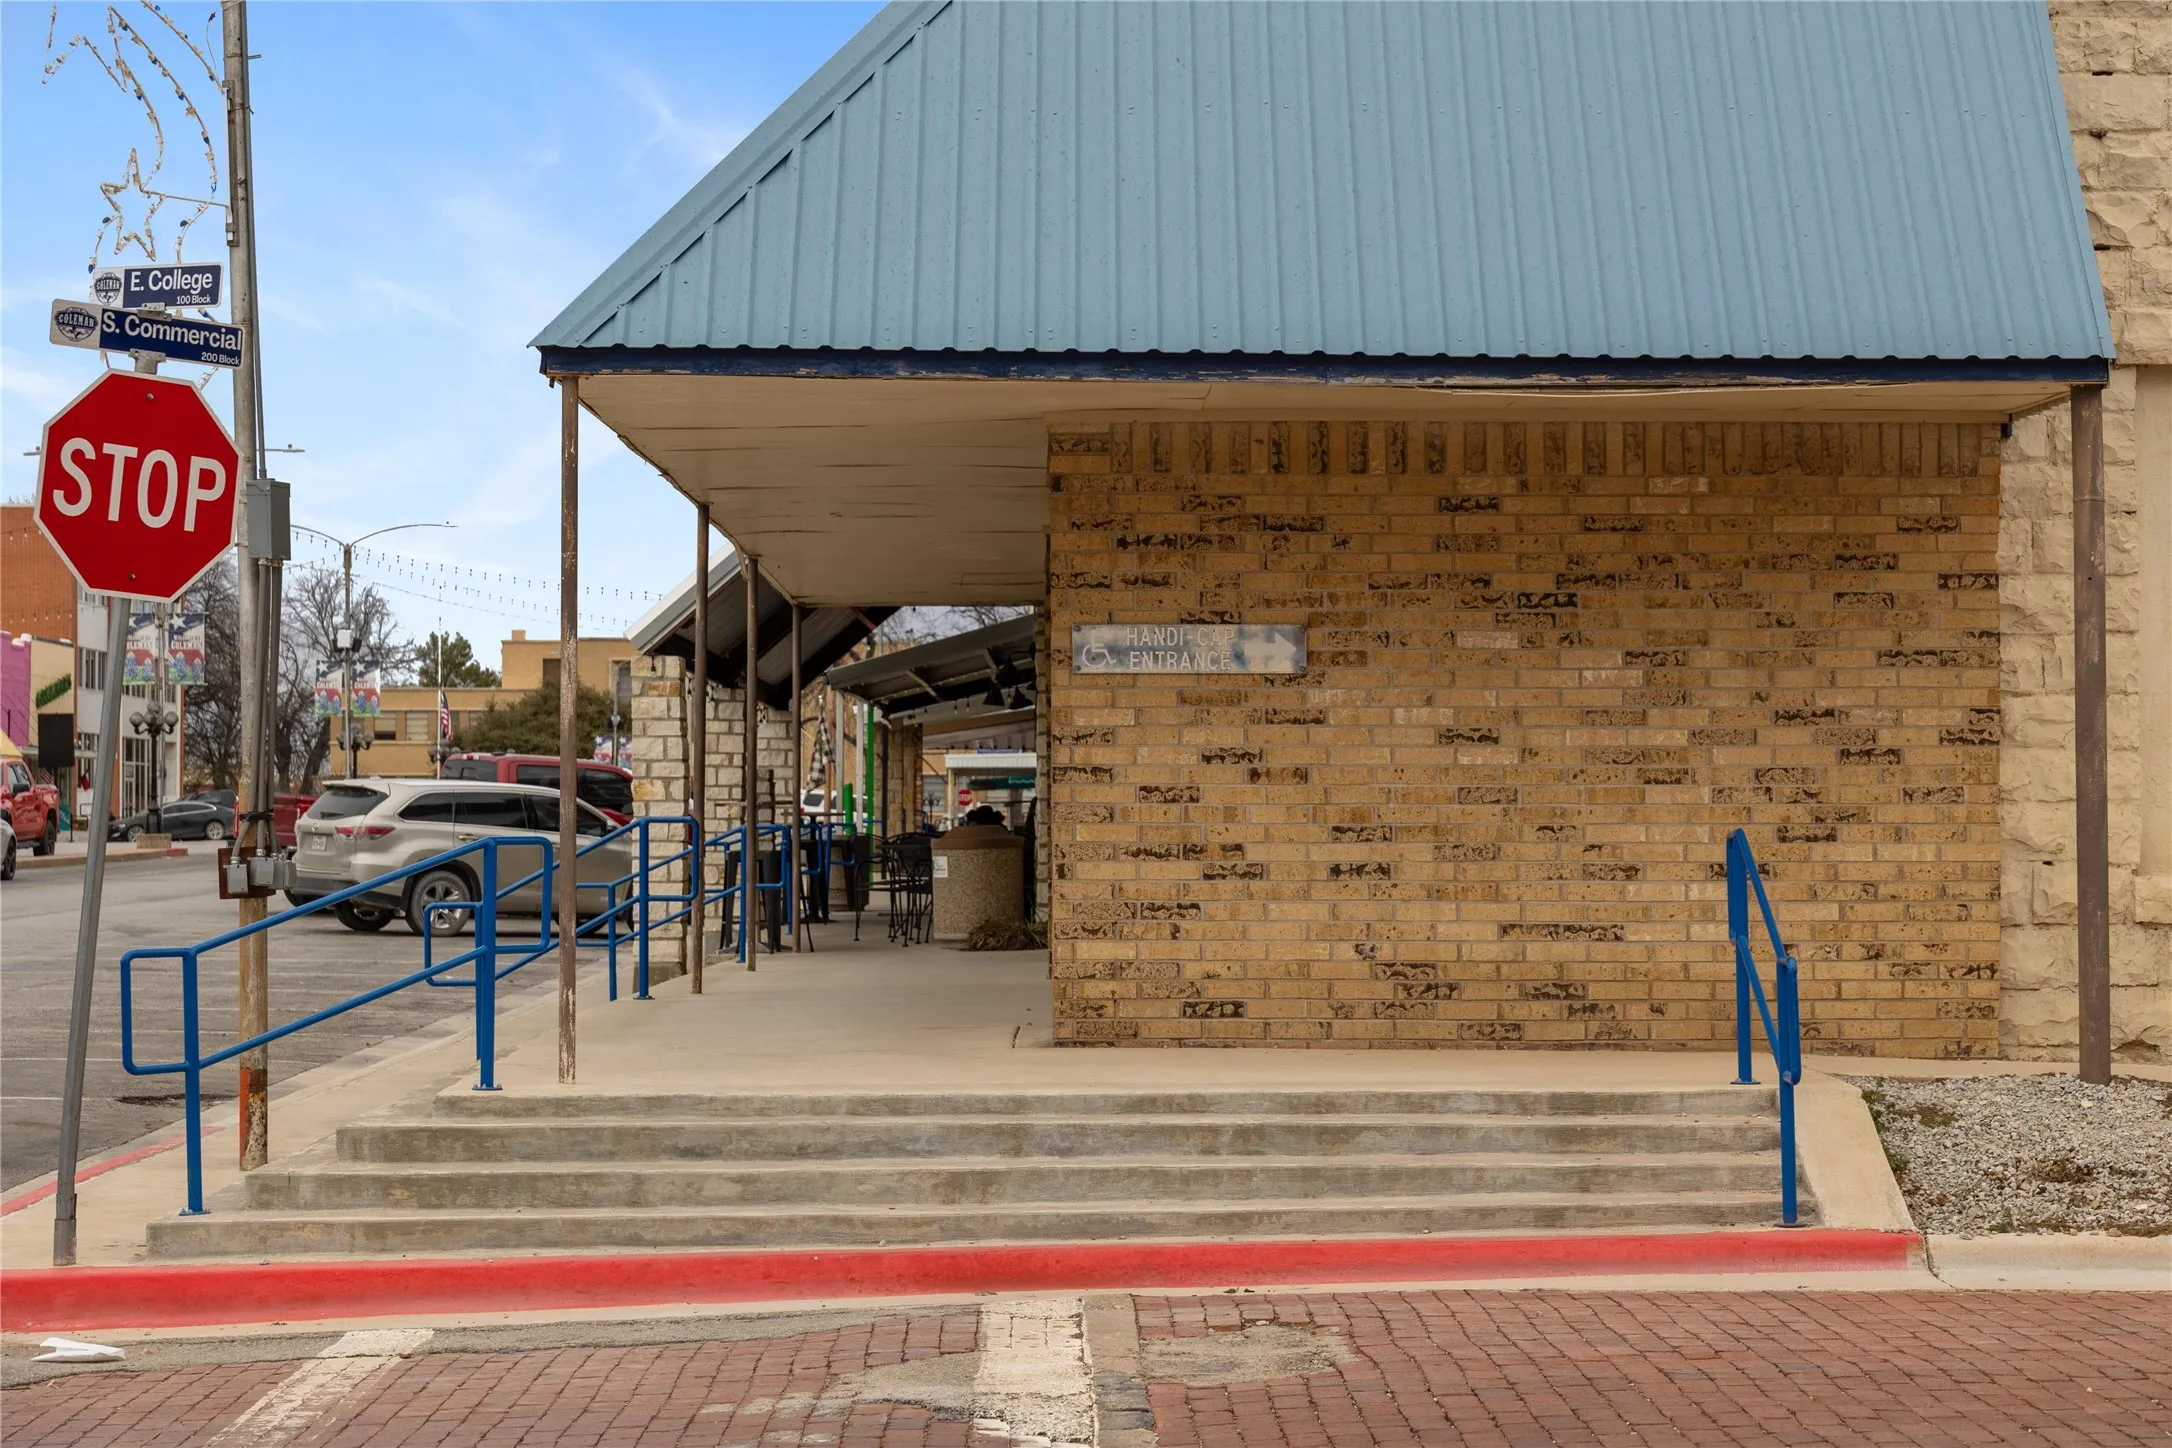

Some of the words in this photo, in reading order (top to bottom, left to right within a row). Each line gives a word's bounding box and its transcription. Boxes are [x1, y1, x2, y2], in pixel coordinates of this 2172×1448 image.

[95, 278, 122, 291] COLEMAN
[130, 271, 145, 292] E.
[148, 268, 213, 295] College
[176, 295, 191, 305] 100
[191, 294, 212, 304] Block
[58, 312, 96, 328] COLEMAN
[102, 311, 120, 334] S.
[124, 315, 242, 351] Commercial
[201, 351, 218, 363] 200
[218, 353, 241, 366] Block
[52, 437, 227, 532] STOP
[1125, 626, 1235, 647] HANDI-CAP
[126, 640, 153, 650] OLEMAN
[170, 640, 204, 650] COLEMAN
[1129, 651, 1233, 671] ENTRANCE
[958, 794, 973, 802] STOP
